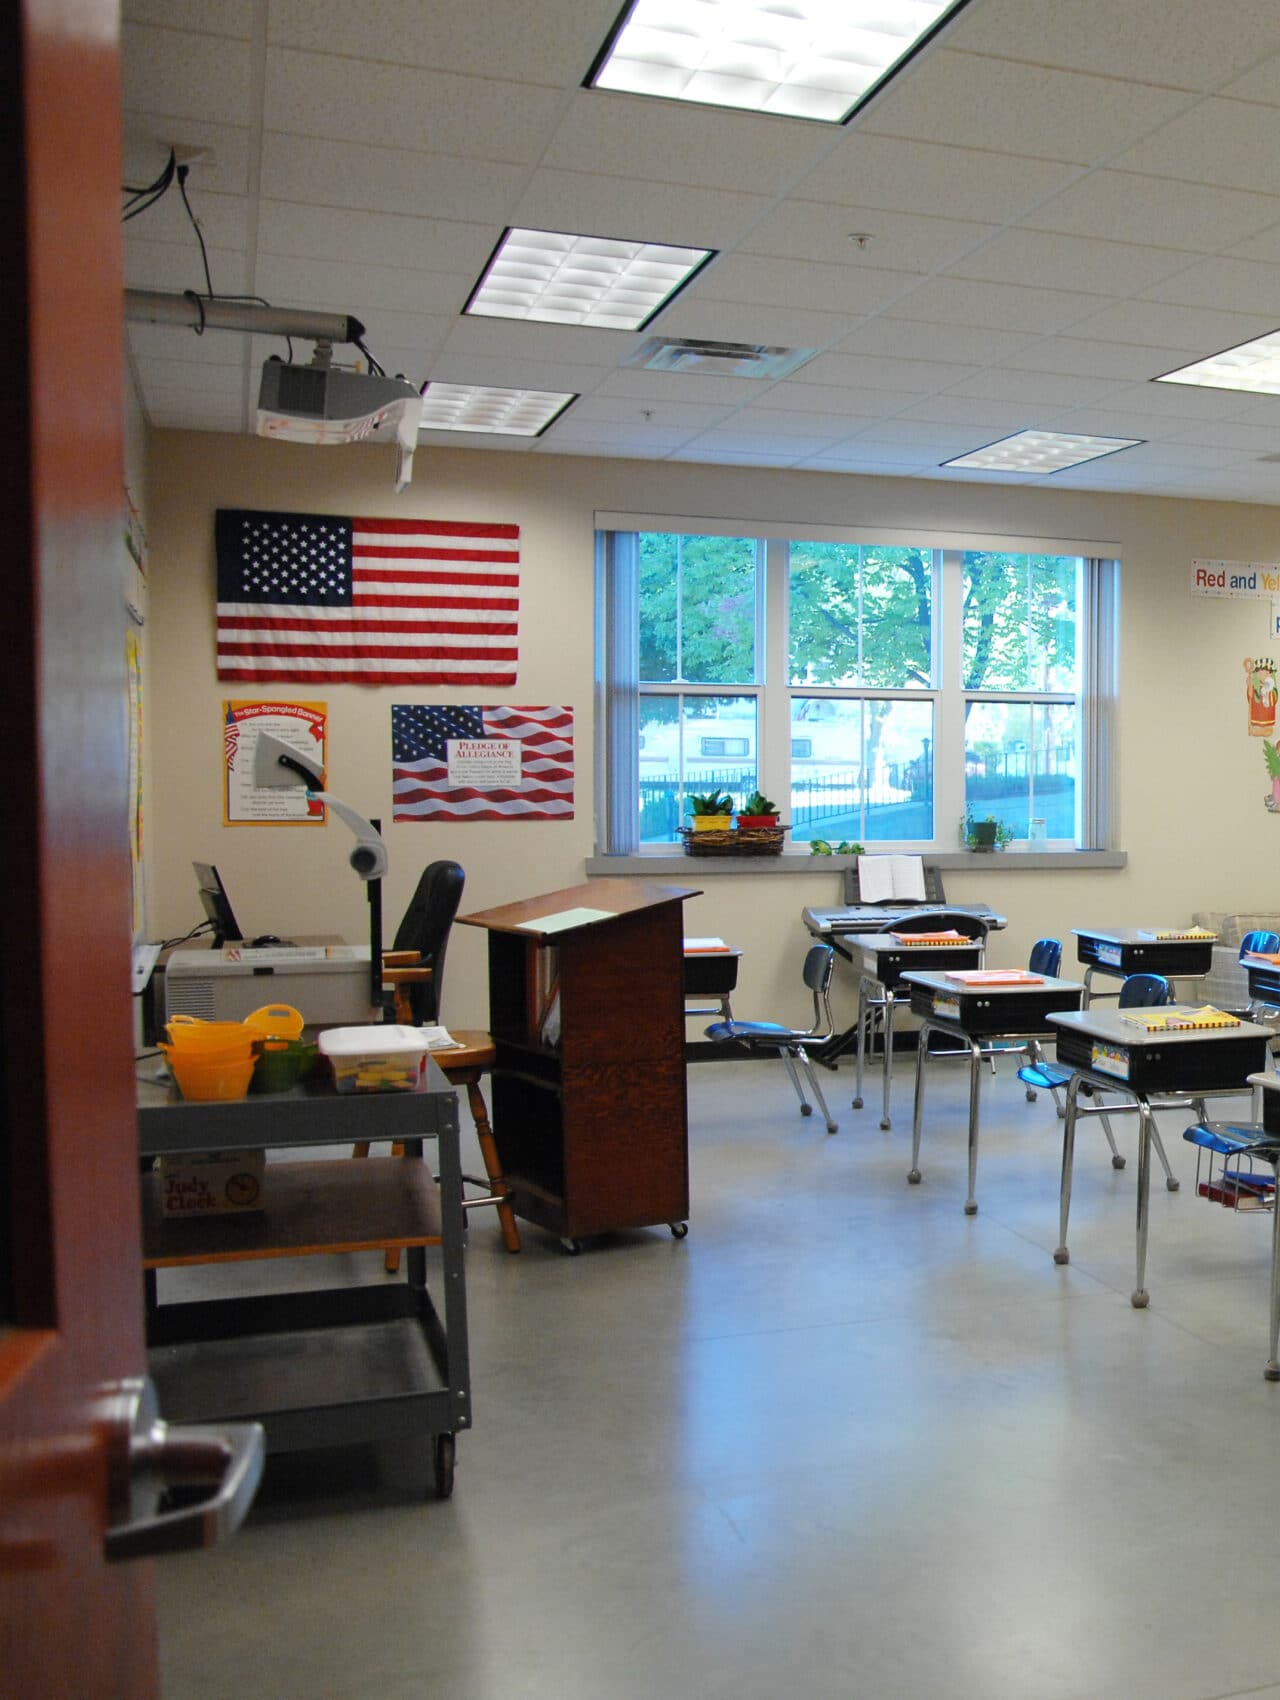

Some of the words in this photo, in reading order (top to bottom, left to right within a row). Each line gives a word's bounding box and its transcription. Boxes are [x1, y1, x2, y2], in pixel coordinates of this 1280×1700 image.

[1195, 568, 1226, 588] Red
[1229, 572, 1257, 590] and
[456, 750, 514, 758] ALLEGIANCE
[459, 741, 497, 750] PLEDGE
[164, 1176, 209, 1195] Judy
[166, 1192, 217, 1211] Clock
